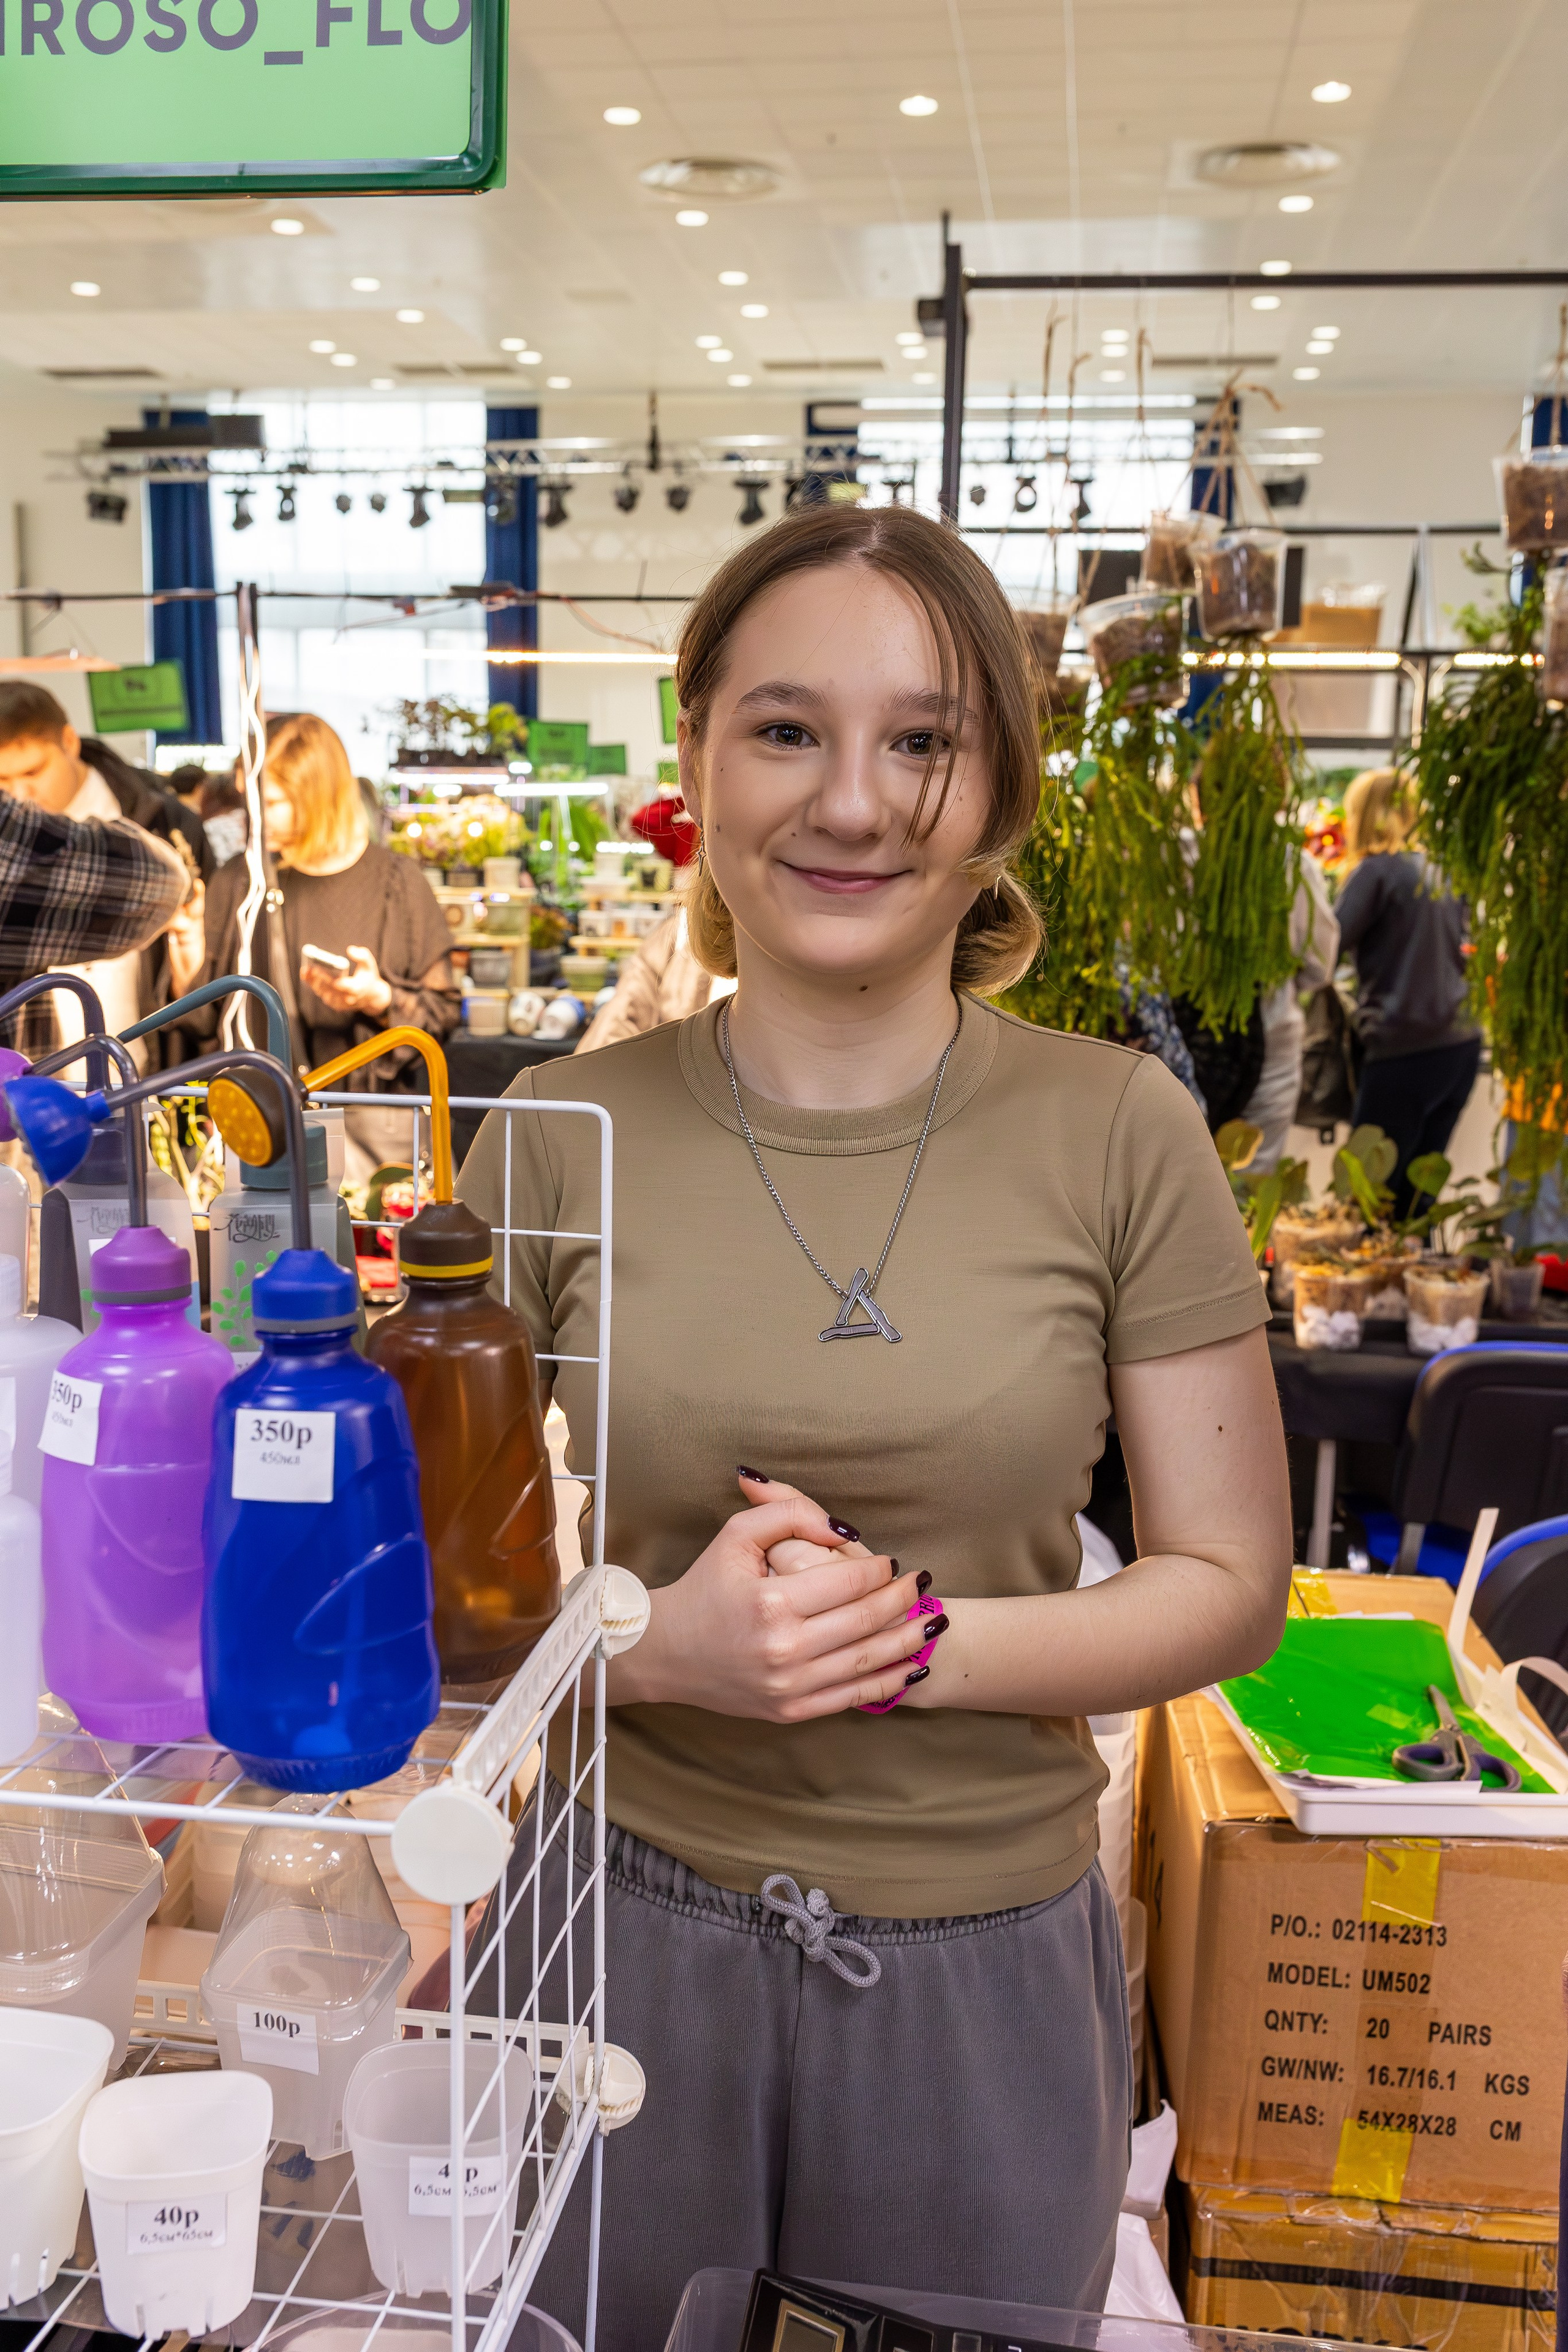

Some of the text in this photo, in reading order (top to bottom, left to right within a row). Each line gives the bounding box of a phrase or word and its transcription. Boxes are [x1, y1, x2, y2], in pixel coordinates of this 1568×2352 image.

[251, 1419, 312, 1449] 350р
[1270, 1913, 1447, 1947] P/O.: 02114-2313
[1268, 1962, 1431, 1994] MODEL: UM502
[254, 2011, 300, 2038] 100р
[1265, 2009, 1492, 2046] QNTY: 20 PAIRS
[1261, 2056, 1530, 2096] GW/NW: 16.7/16.1 KGS
[1257, 2101, 1522, 2142] MEAS: 54X28X28 CM
[438, 2163, 478, 2182] 4р
[154, 2206, 199, 2229] 40р
